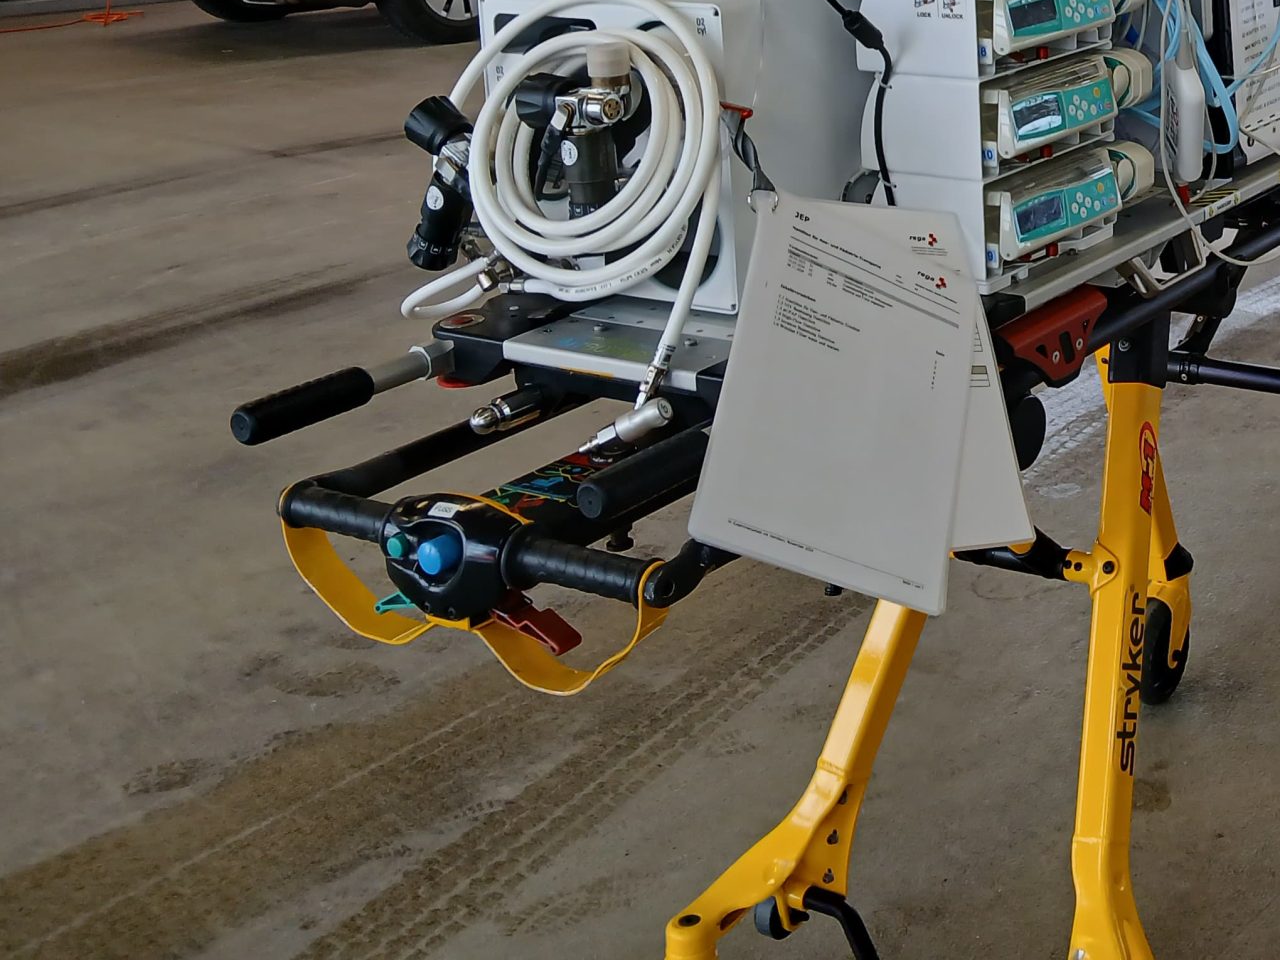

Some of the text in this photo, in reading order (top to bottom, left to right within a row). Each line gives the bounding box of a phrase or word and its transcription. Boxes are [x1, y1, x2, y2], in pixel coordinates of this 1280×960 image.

[980, 46, 987, 57] 8
[917, 270, 935, 282] rega
[1116, 591, 1147, 777] stryker
